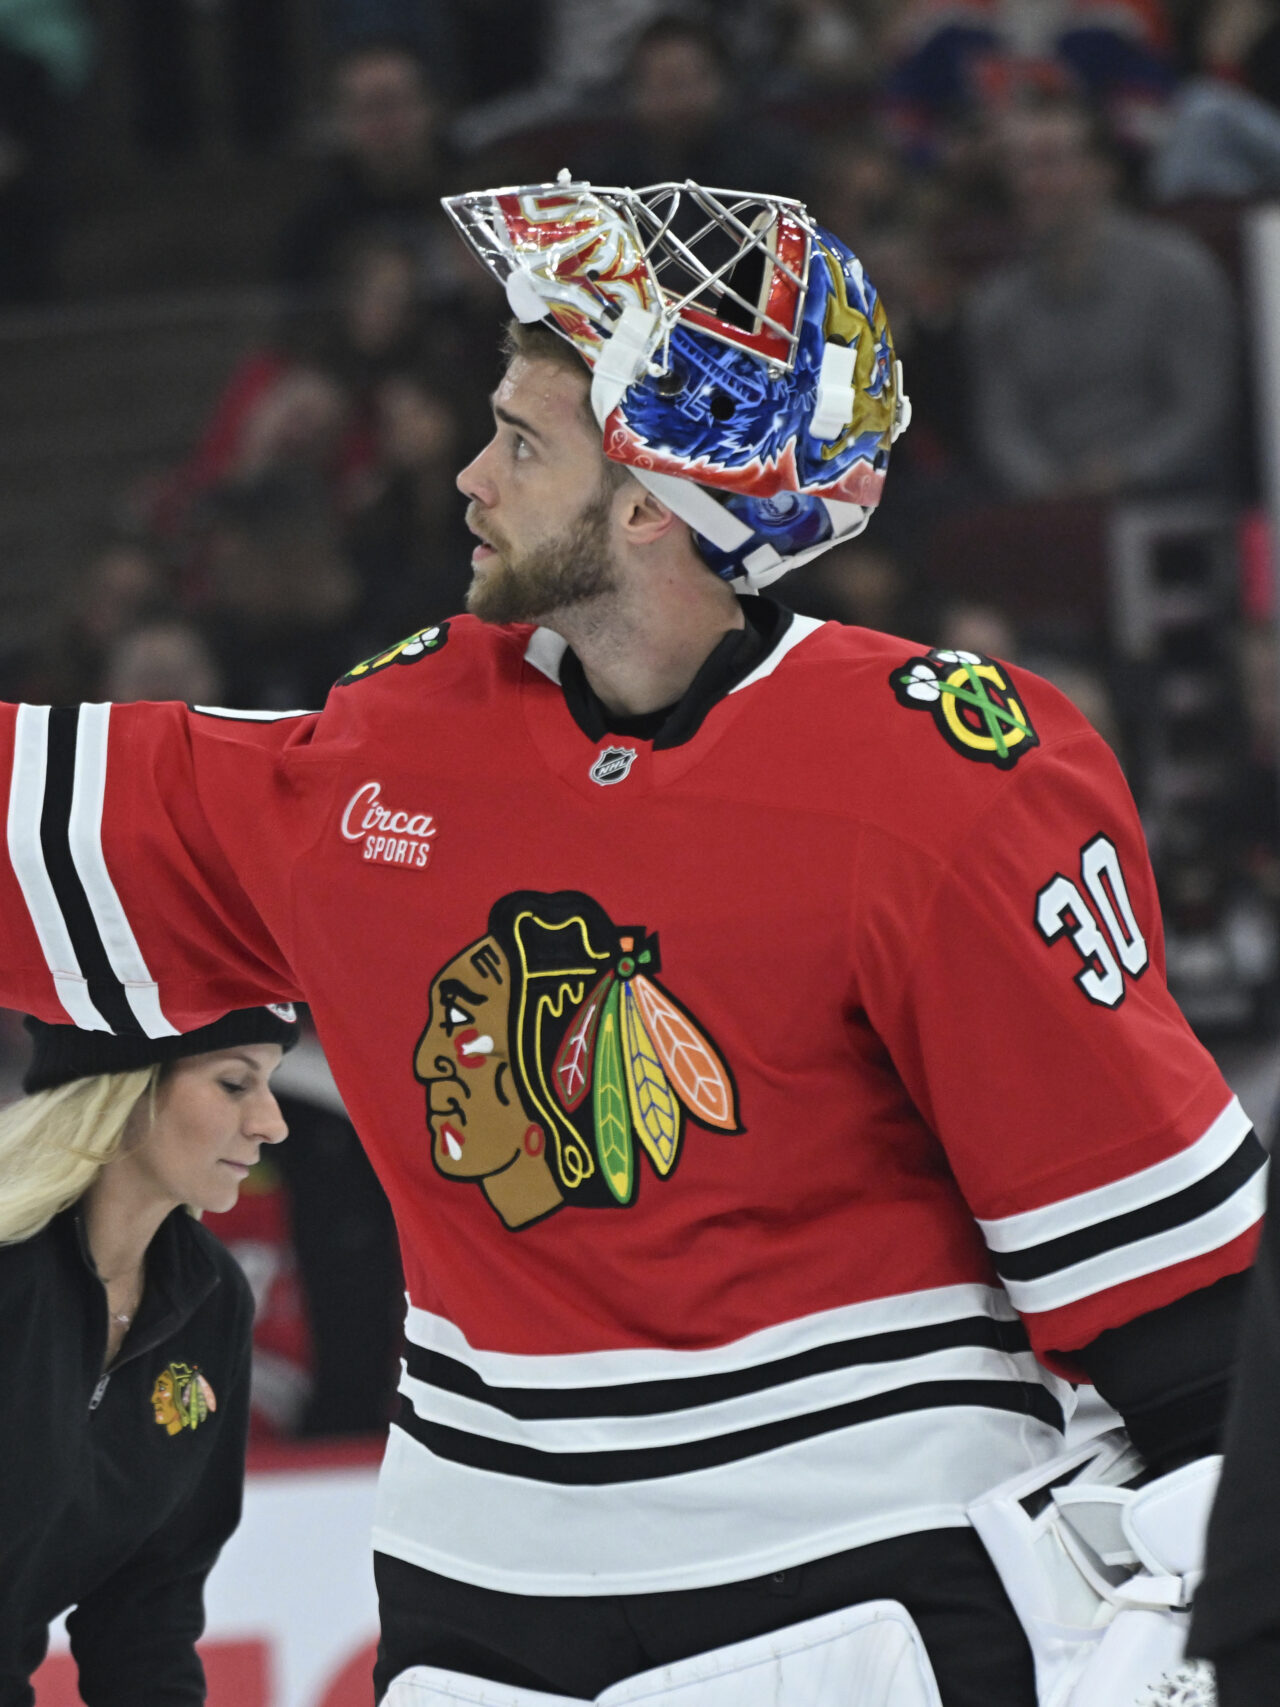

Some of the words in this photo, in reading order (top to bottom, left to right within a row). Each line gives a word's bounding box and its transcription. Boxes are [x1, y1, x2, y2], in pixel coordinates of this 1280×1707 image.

[597, 757, 627, 776] NHL
[341, 781, 437, 840] Circa
[363, 835, 430, 867] SPORTS
[1035, 832, 1149, 1008] 30
